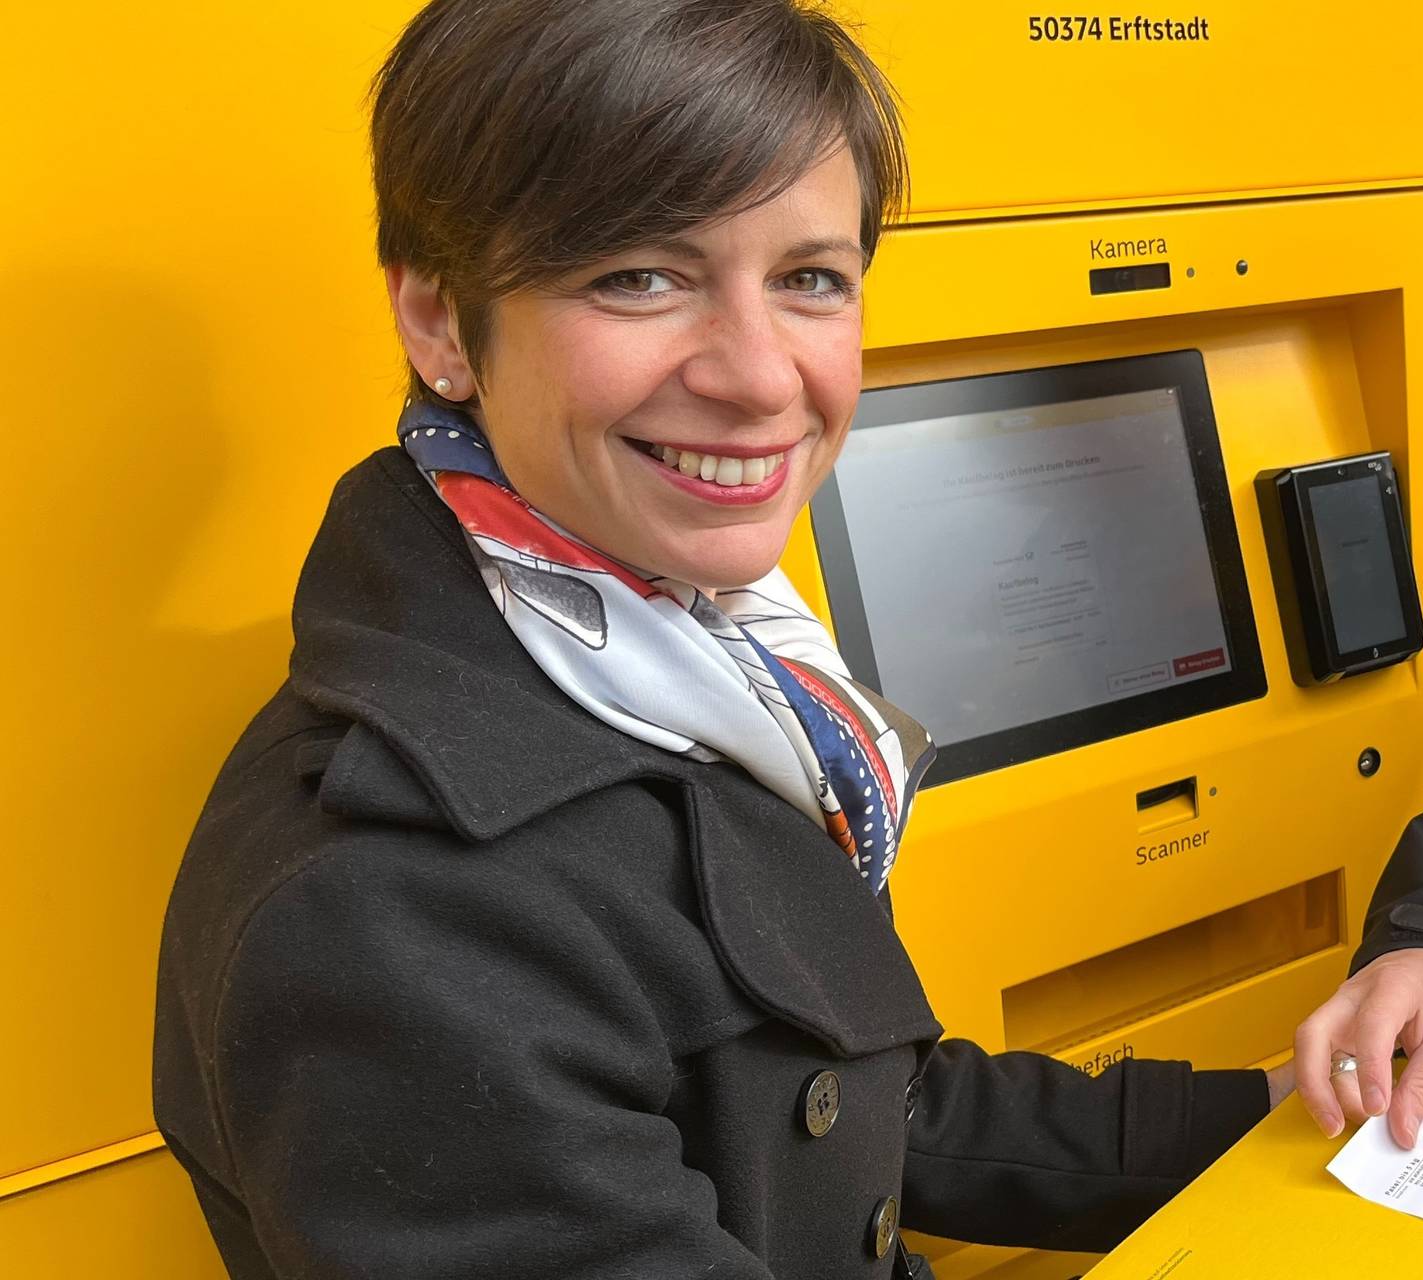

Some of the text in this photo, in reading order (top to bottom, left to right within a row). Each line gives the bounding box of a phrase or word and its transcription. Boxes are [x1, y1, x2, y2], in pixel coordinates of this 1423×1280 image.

[1029, 15, 1209, 41] 50374 Erftstadt
[1090, 238, 1168, 260] Kamera
[1136, 829, 1211, 866] Scanner
